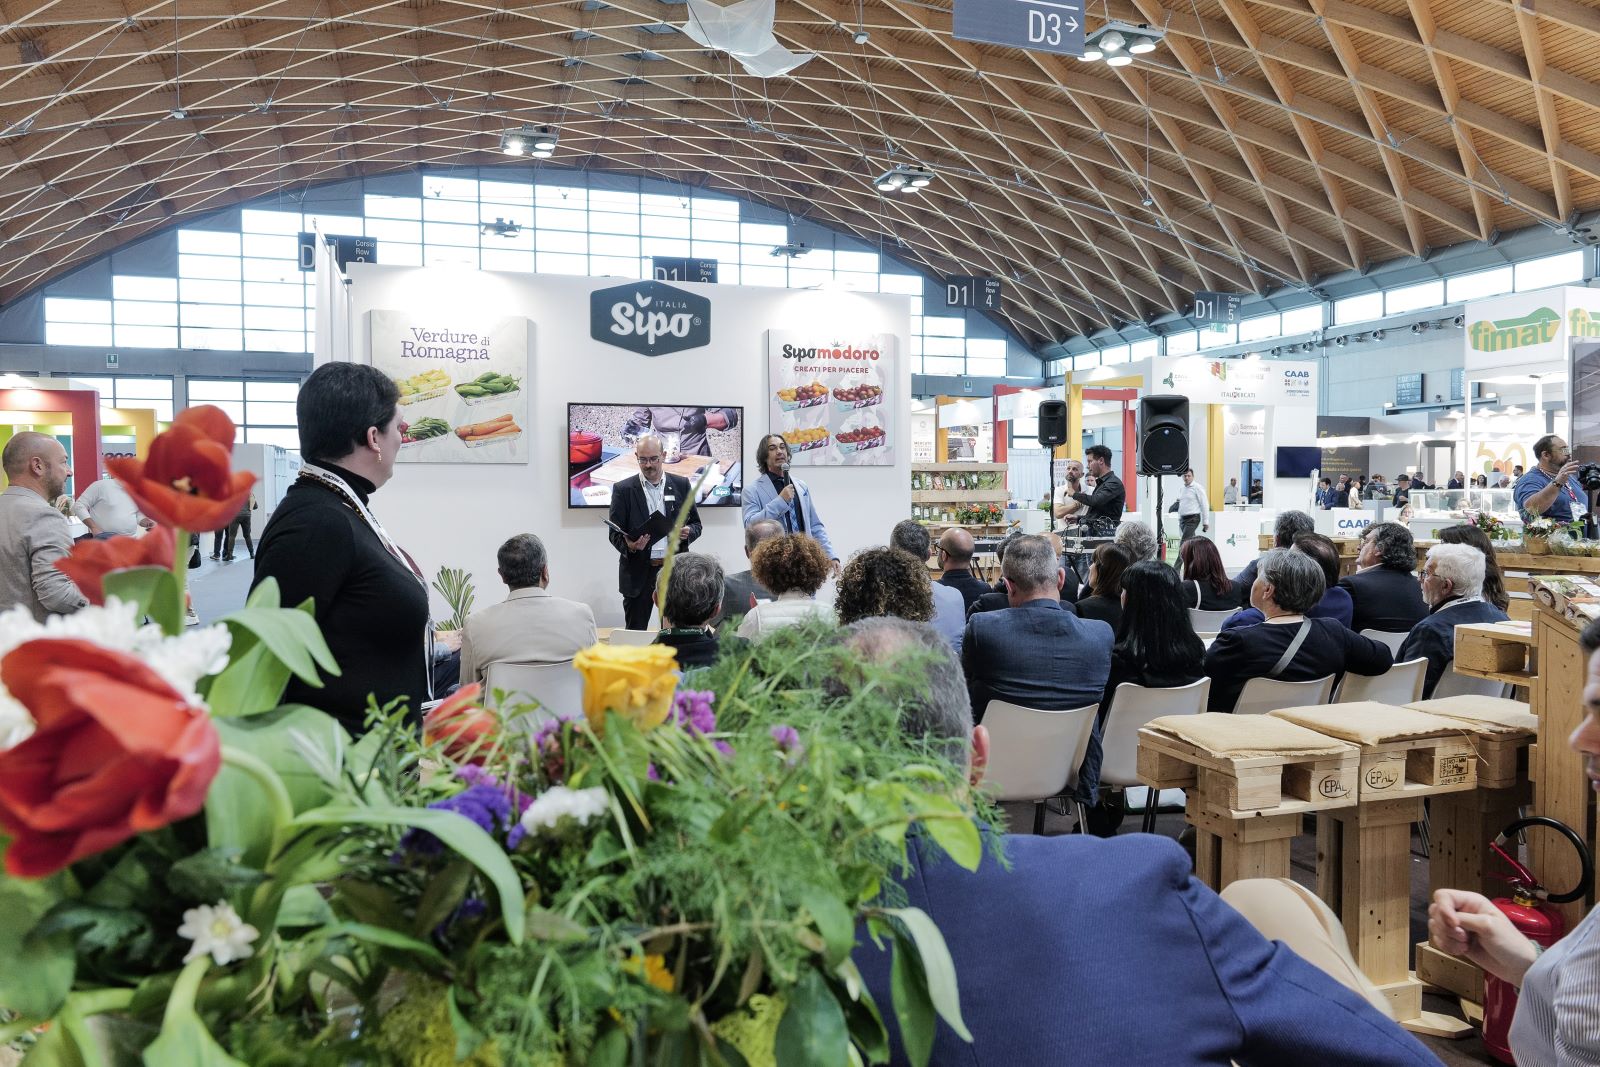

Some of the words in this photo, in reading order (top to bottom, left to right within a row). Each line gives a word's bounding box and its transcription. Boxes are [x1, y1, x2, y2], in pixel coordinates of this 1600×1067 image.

[1028, 9, 1061, 46] D3
[355, 239, 376, 248] Corsia
[355, 247, 370, 256] Row
[985, 279, 1000, 287] Corsia
[947, 284, 968, 306] D1
[985, 294, 993, 307] 4
[655, 300, 688, 309] ITALIA
[1195, 299, 1213, 320] D1
[1228, 308, 1234, 321] 5
[610, 301, 694, 345] Sipo
[410, 327, 478, 345] Verdure
[480, 336, 490, 346] di
[1471, 317, 1553, 352] fimat
[400, 340, 491, 363] Romagna
[822, 366, 837, 374] PER
[838, 367, 869, 375] PIACERE
[1284, 370, 1310, 378] CAAB
[1370, 770, 1394, 785] EPAL
[1324, 778, 1347, 793] EPAL
